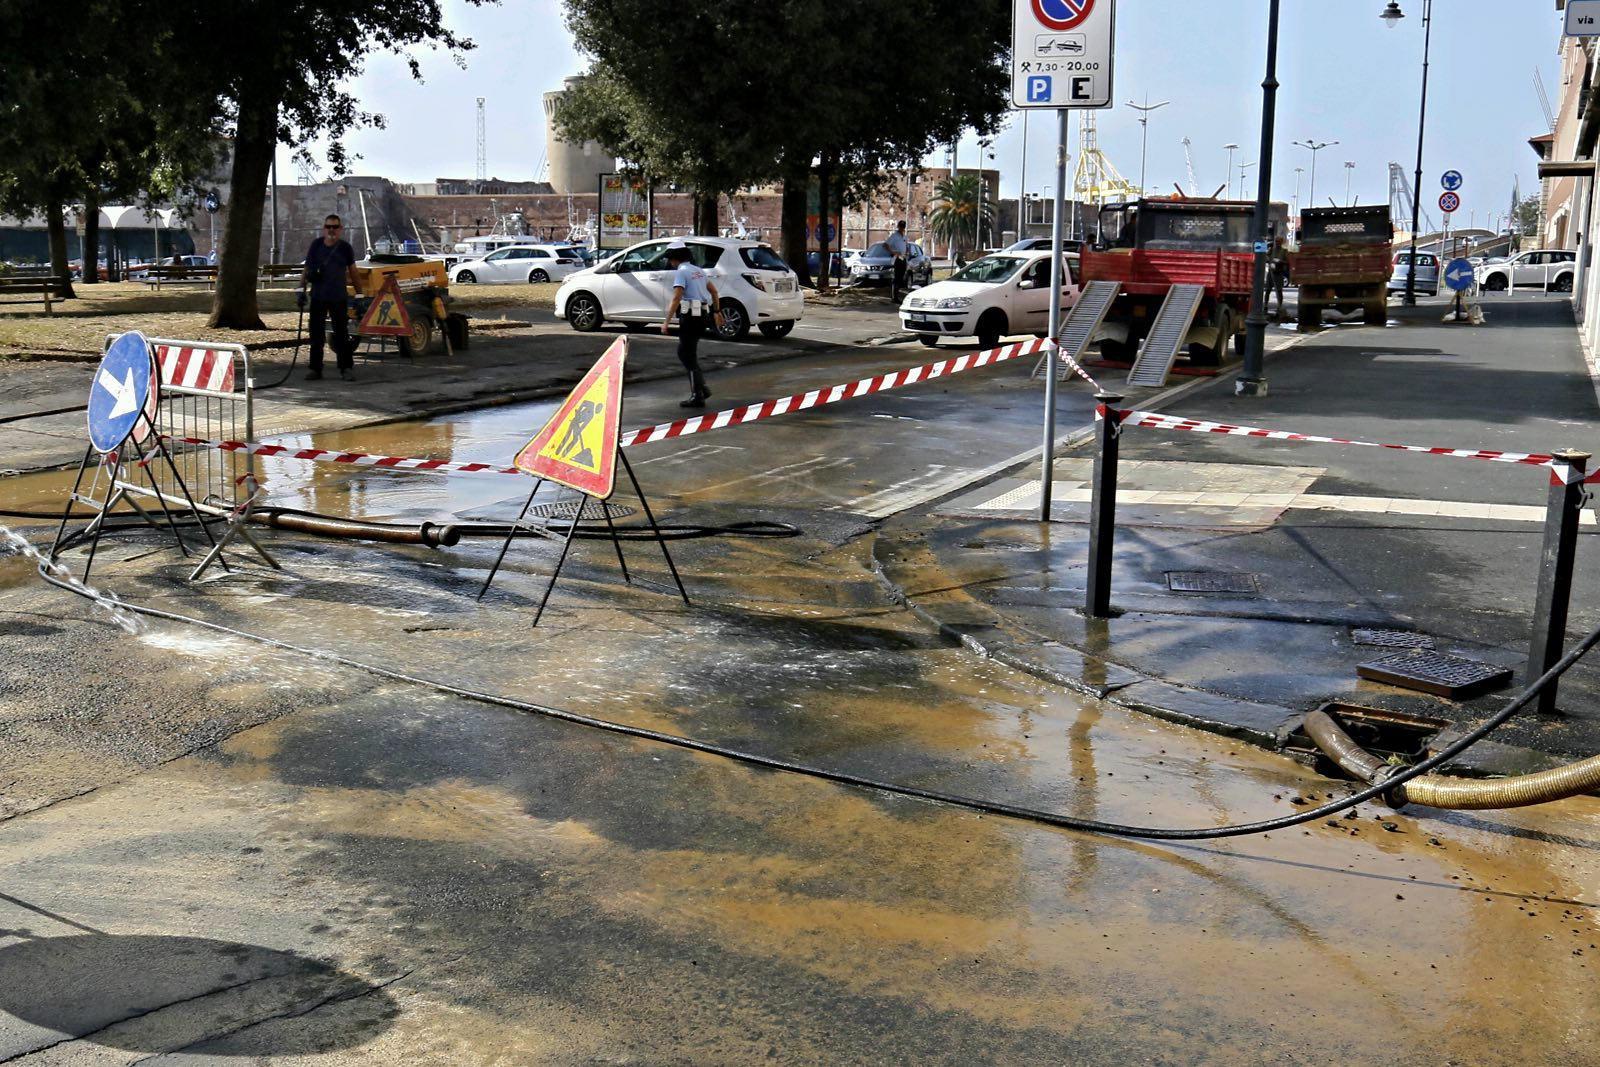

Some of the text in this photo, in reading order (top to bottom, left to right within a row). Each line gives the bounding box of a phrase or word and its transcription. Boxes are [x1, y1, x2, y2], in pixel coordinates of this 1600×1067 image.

[1577, 15, 1594, 24] via
[1067, 62, 1099, 71] 20.00
[1032, 79, 1047, 99] P
[1071, 77, 1090, 100] E
